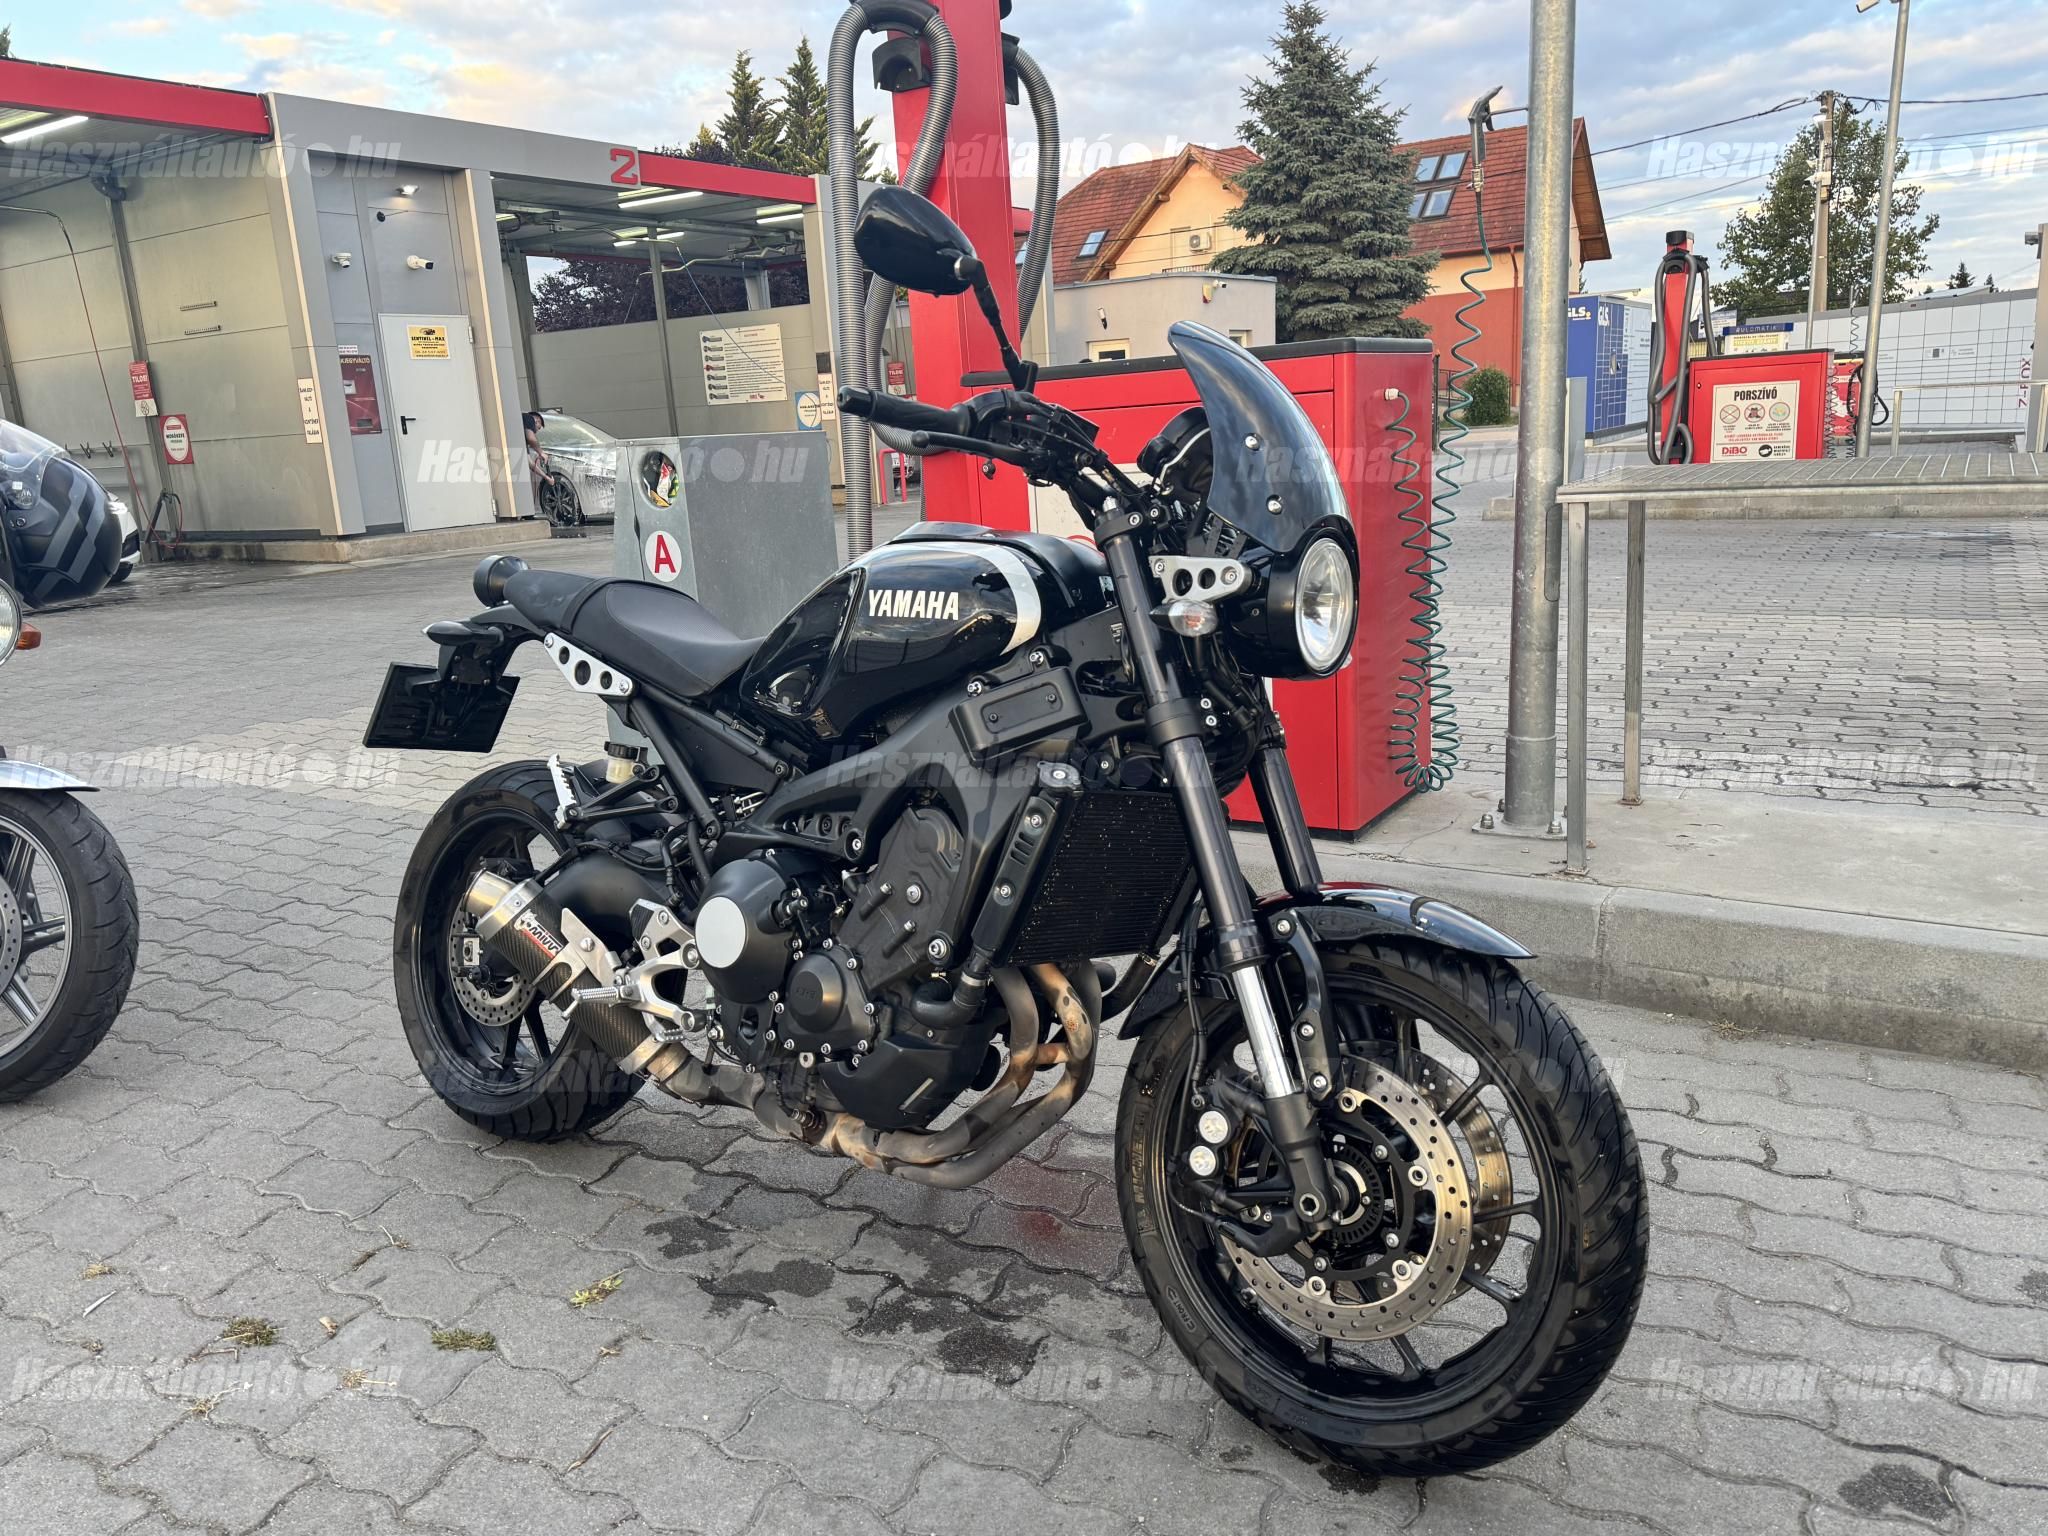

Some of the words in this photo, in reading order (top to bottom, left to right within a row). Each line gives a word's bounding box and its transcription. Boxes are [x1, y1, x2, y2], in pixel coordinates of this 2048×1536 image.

[610, 148, 639, 185] 2
[1734, 387, 1777, 401] PORSZÍVÓ
[654, 534, 676, 574] A
[868, 589, 959, 621] YAMAHA
